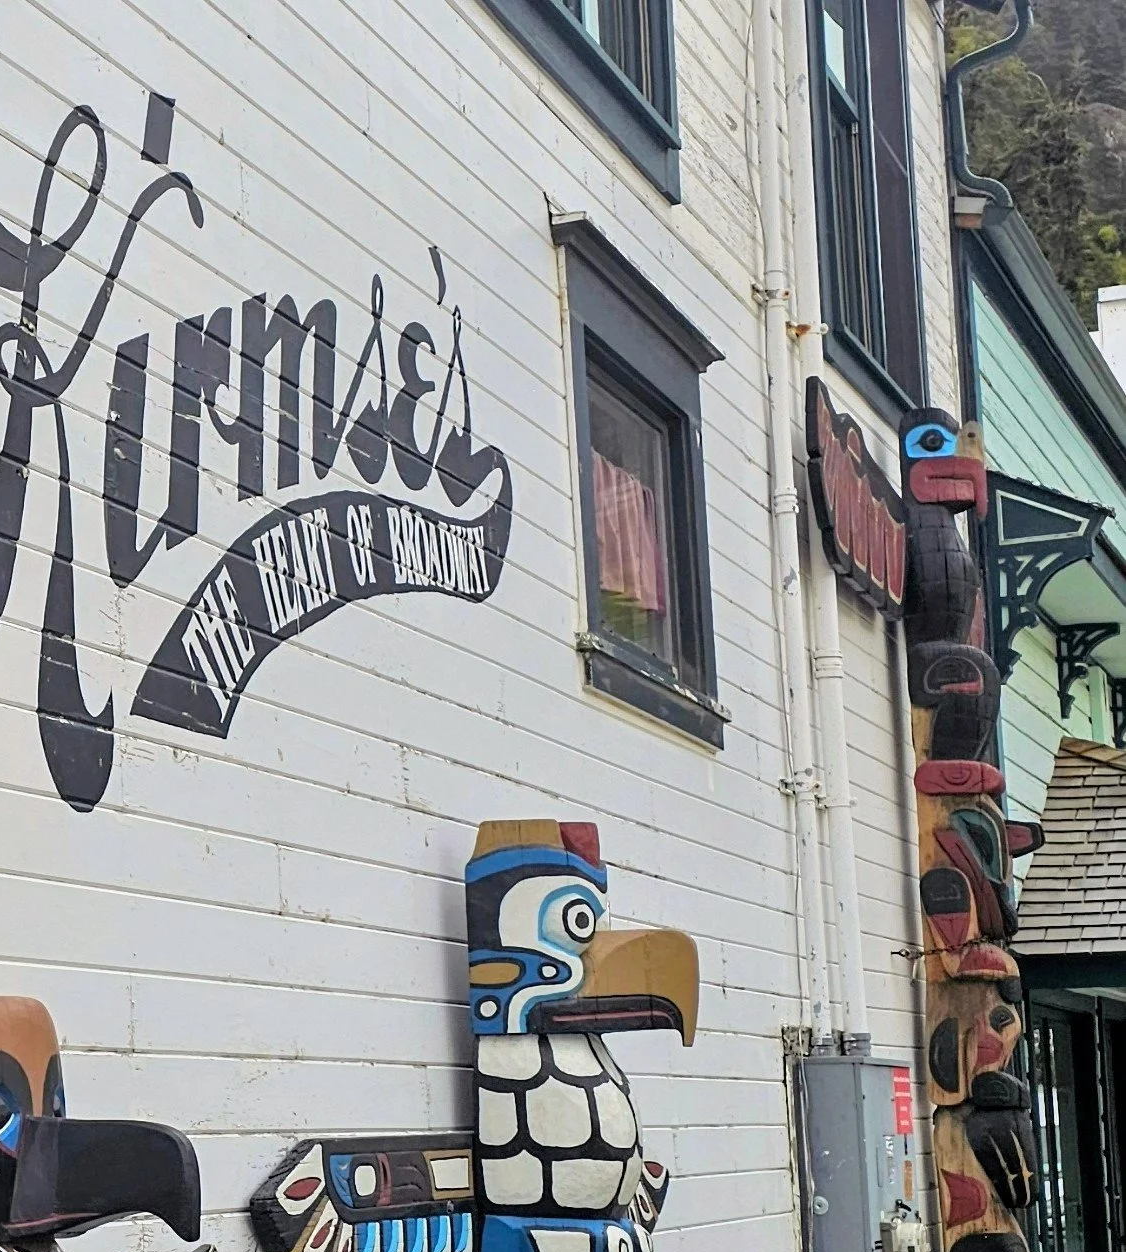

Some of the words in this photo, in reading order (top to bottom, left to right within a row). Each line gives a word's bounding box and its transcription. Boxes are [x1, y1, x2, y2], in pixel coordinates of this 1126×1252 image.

[182, 564, 257, 724] THE
[251, 507, 336, 634] HEART
[345, 503, 376, 586] OF
[387, 507, 491, 593] BROADWAY
